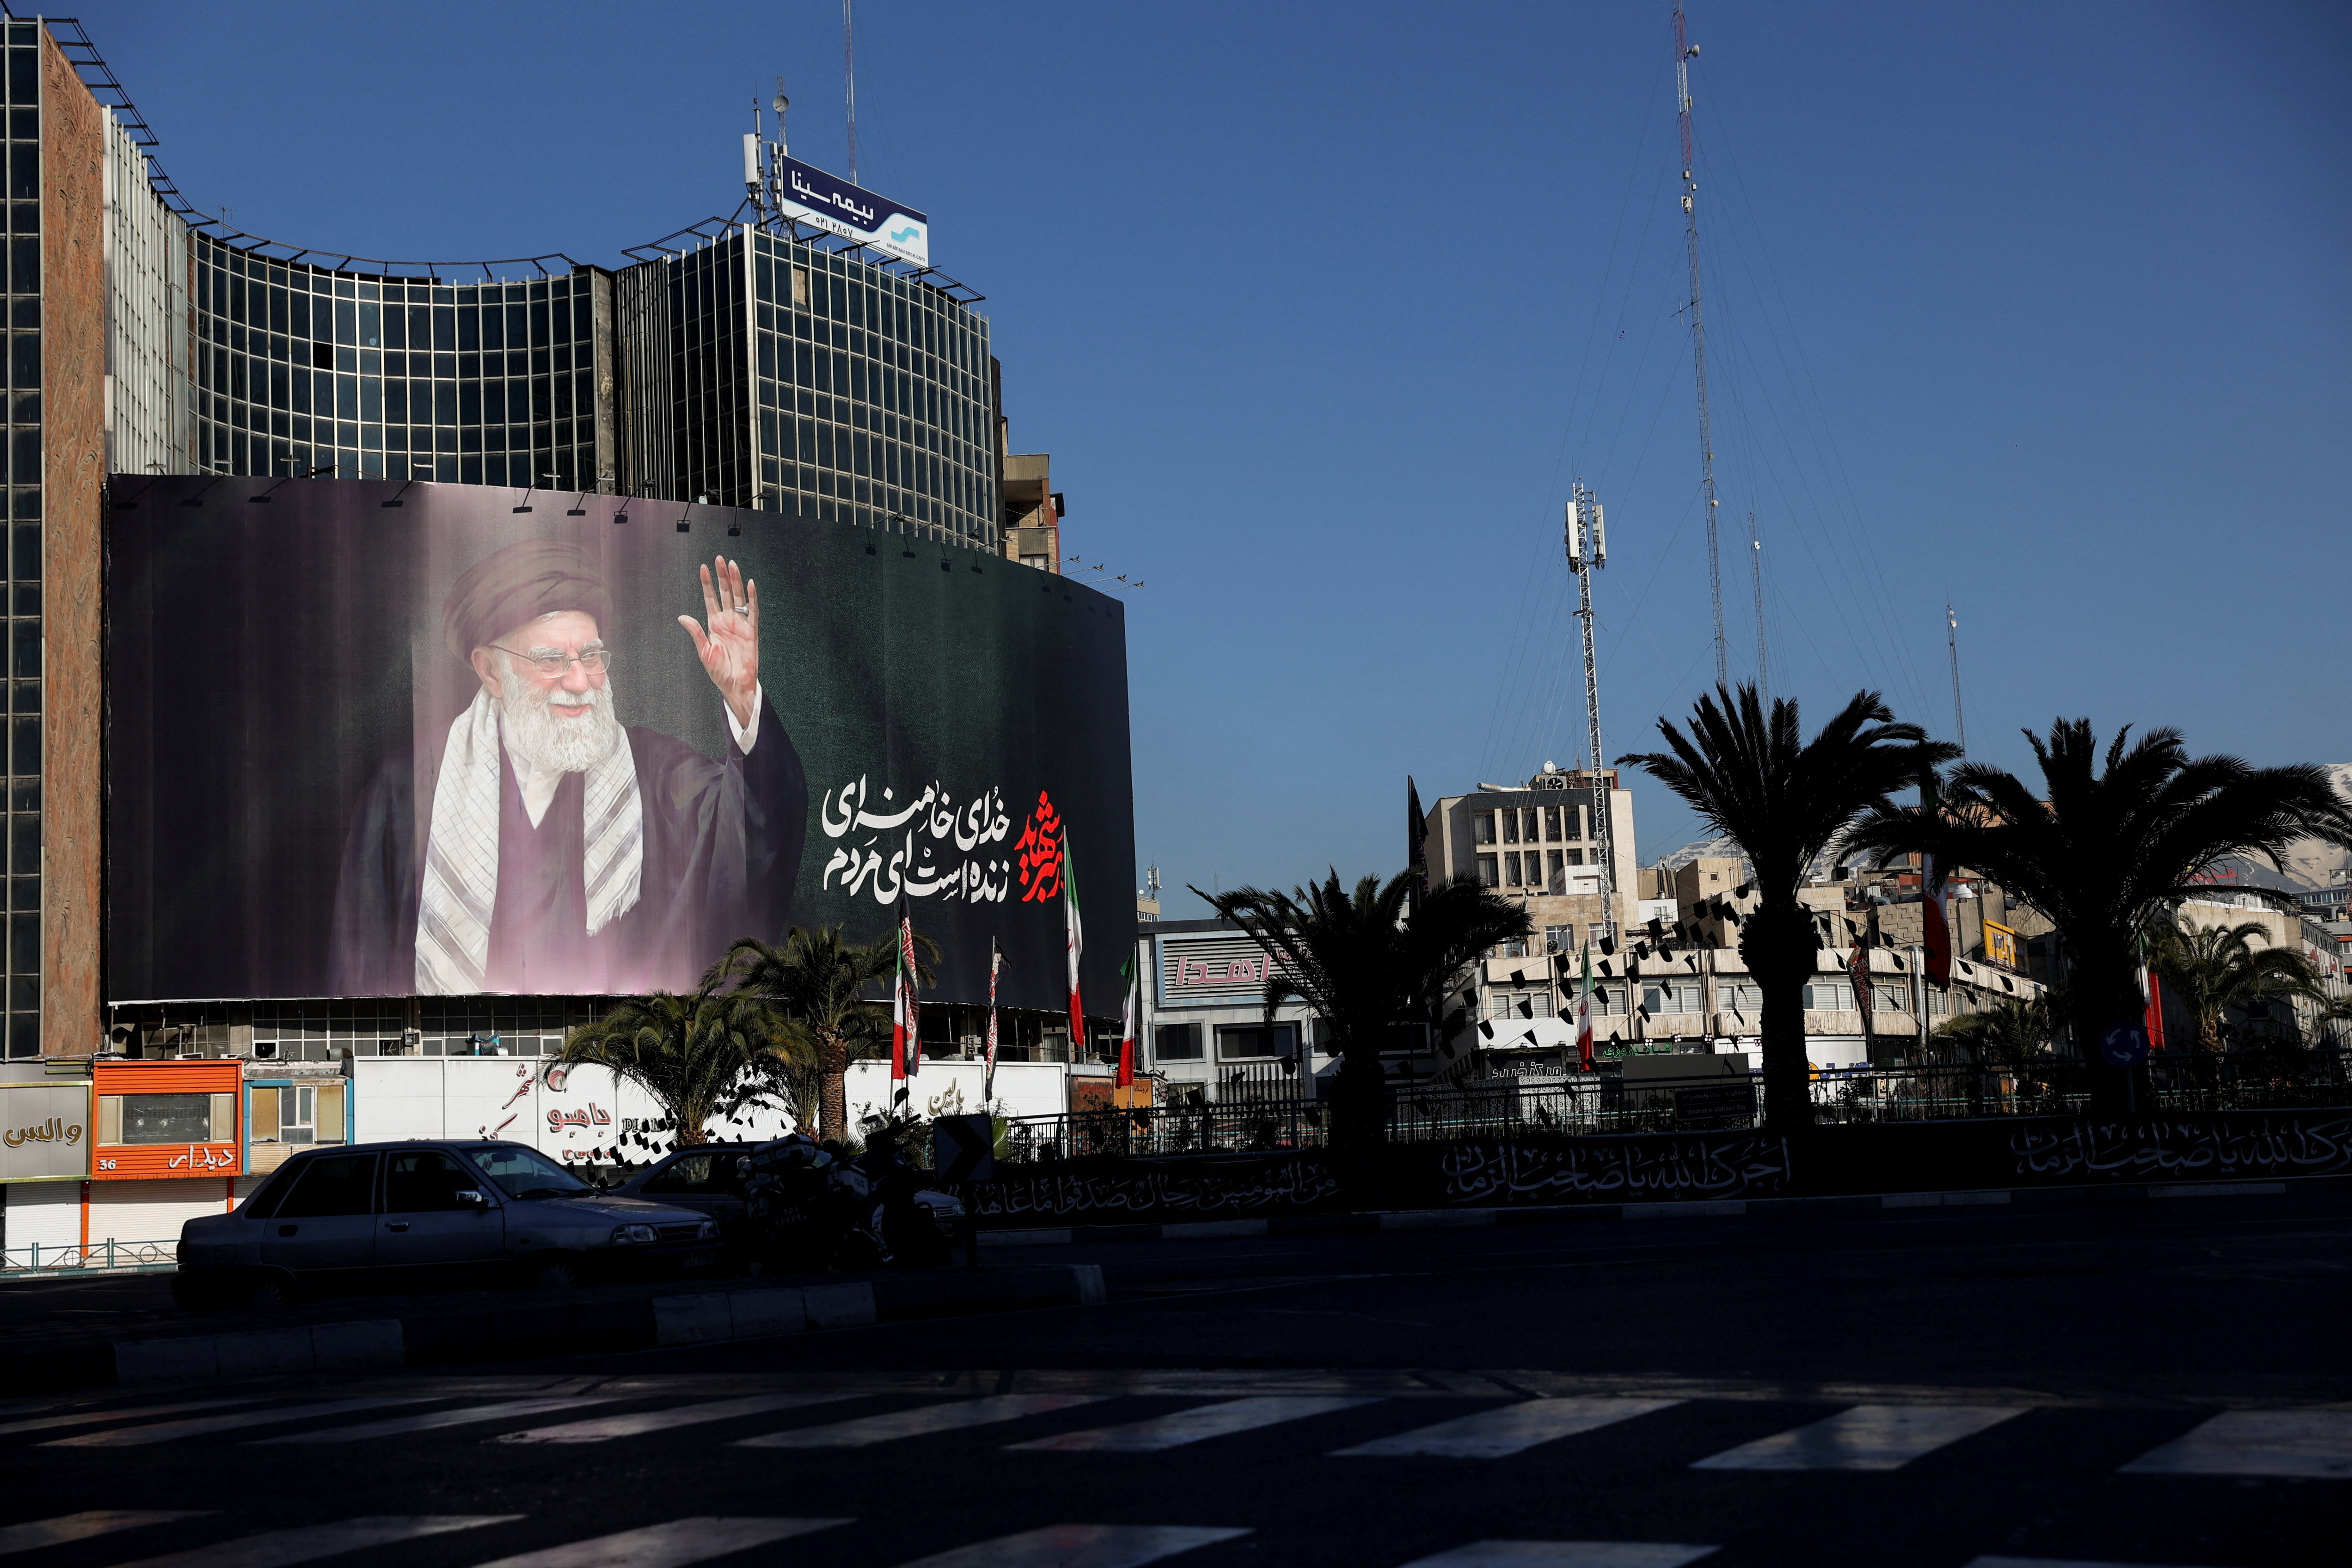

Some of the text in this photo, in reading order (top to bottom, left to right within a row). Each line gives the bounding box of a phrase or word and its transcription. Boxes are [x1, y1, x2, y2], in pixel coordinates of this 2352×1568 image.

[792, 170, 874, 225] بیمه سینا
[886, 243, 925, 262] sinainsurance.com
[824, 836, 882, 896] مردم
[904, 847, 967, 901] است
[969, 859, 1009, 903] زنده
[1134, 1085, 1149, 1094] فروشگاه
[4, 1116, 83, 1147] والس
[99, 1159, 116, 1170] 36
[168, 1145, 234, 1170] دیدار
[854, 1176, 865, 1189] POLICE
